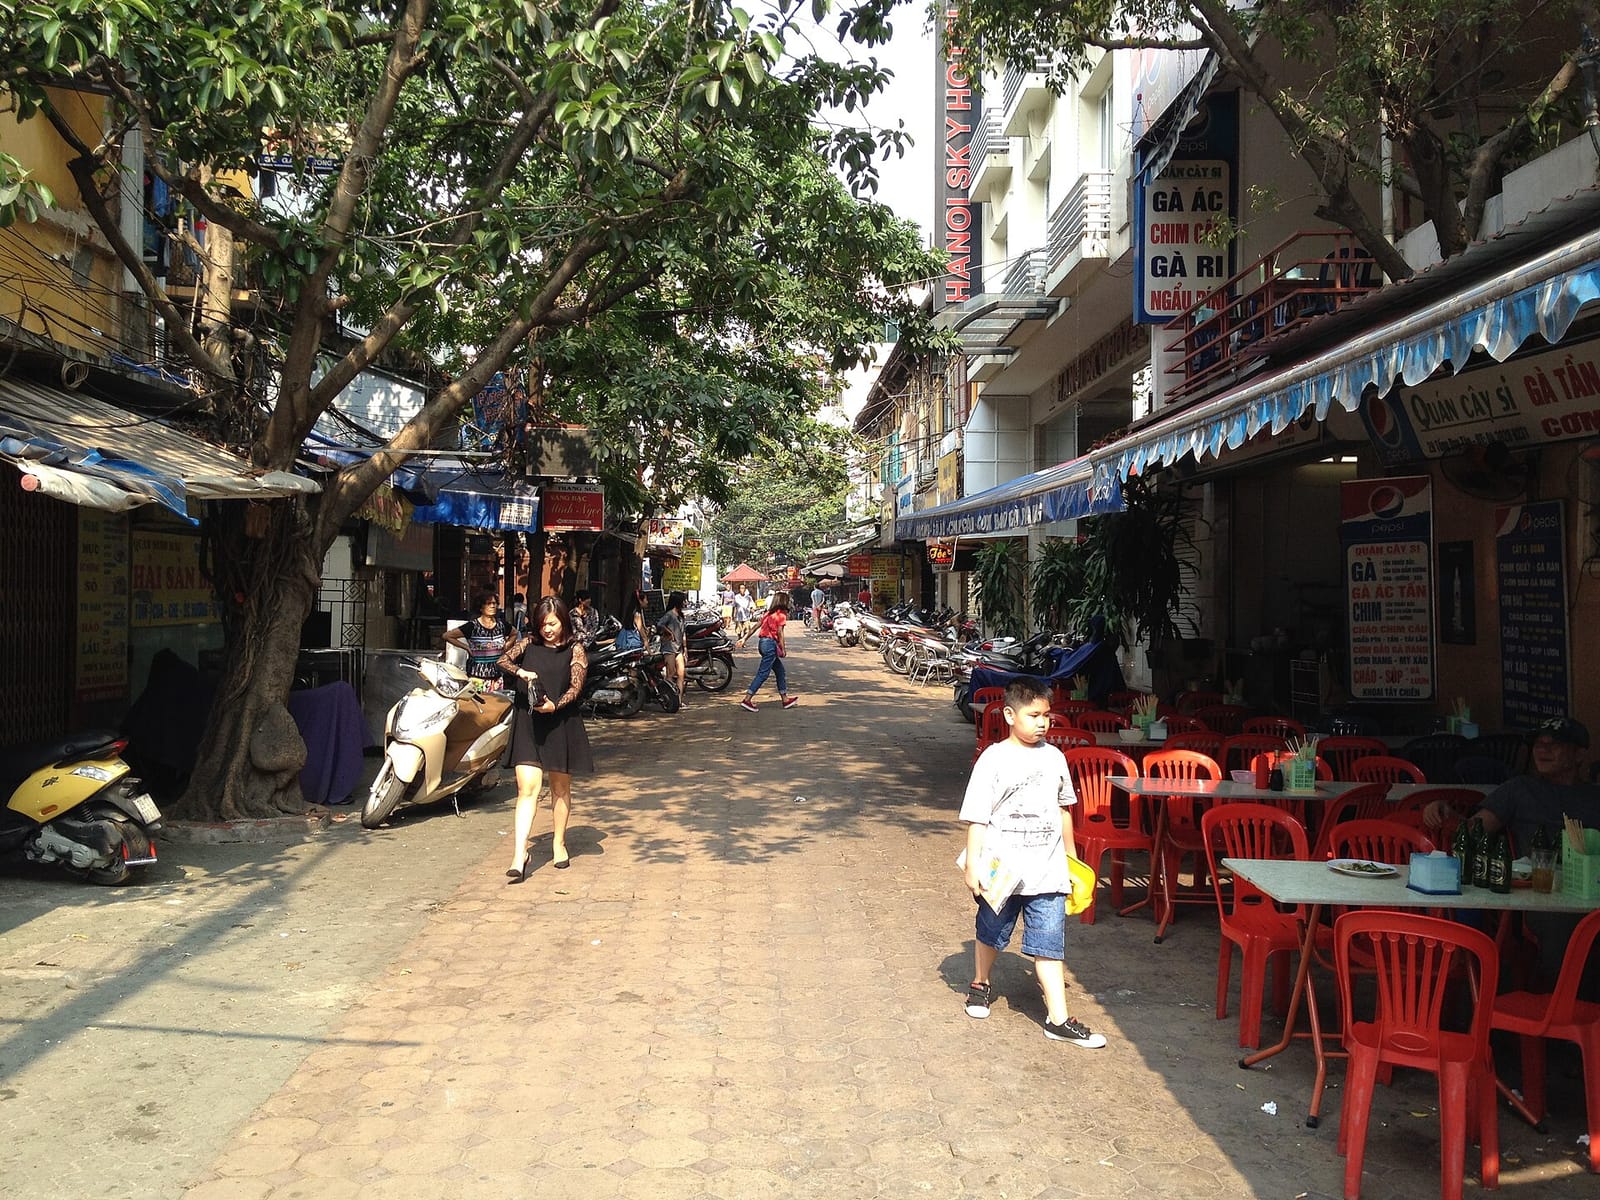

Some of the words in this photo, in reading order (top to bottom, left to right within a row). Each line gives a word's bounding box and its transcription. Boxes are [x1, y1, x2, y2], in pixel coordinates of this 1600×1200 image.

[945, 117, 971, 190] SKY
[1152, 186, 1184, 213] GÀ
[1191, 187, 1223, 213] ÁC
[1150, 222, 1190, 246] CHIM
[945, 198, 971, 303] HANOI
[1150, 251, 1188, 278] GÀ
[1197, 255, 1224, 278] RI
[1150, 282, 1193, 311] NGẨU
[1523, 366, 1559, 408] GÀ
[1461, 384, 1494, 423] CÂY
[1351, 556, 1377, 582] GÀ
[1351, 583, 1370, 600] GÀ
[1352, 601, 1382, 622] CHIM
